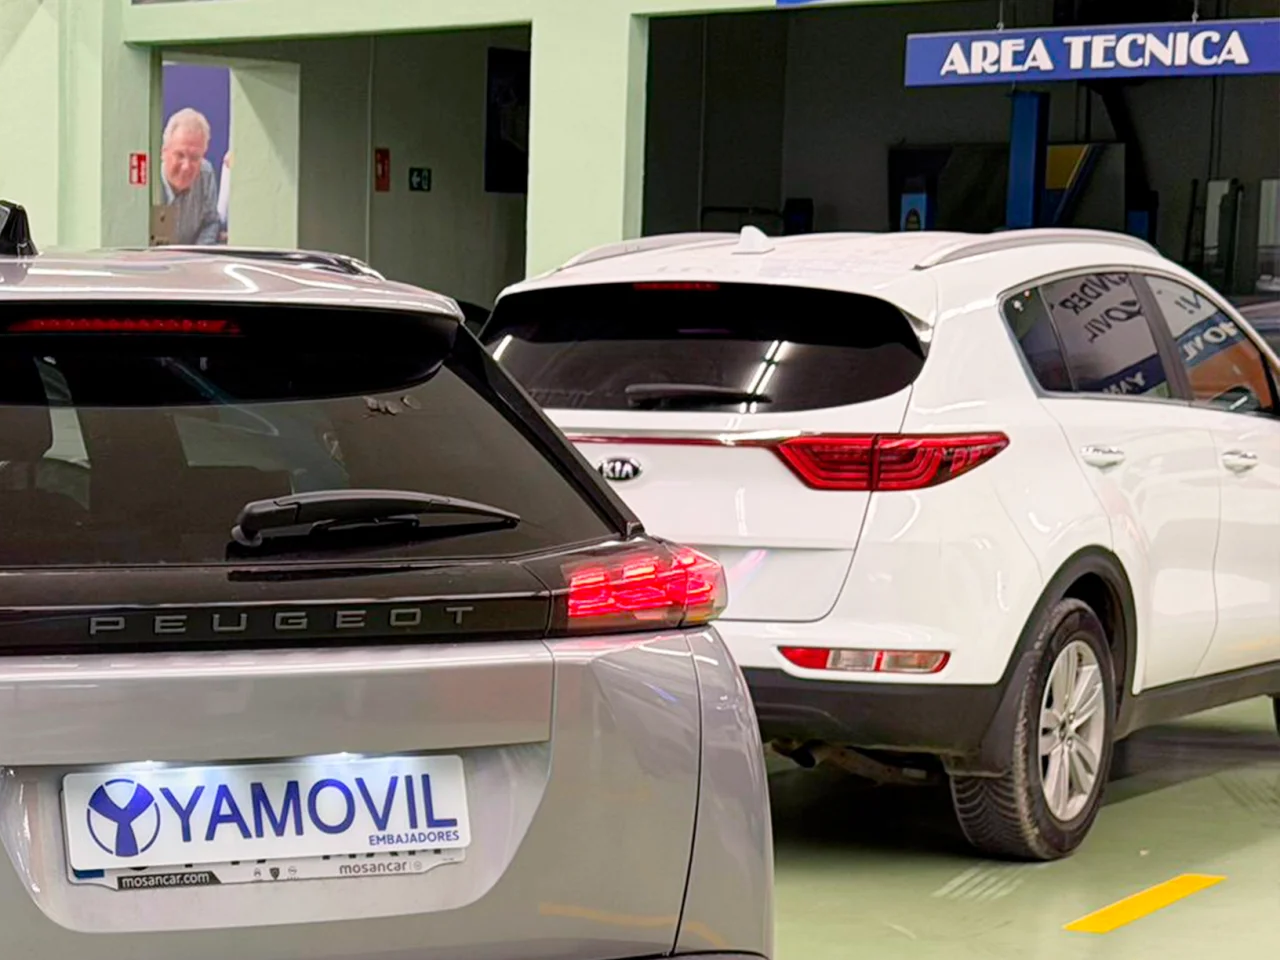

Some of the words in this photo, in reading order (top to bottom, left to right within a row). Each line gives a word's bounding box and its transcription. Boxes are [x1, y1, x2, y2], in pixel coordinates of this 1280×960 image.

[940, 37, 1054, 76] AREA
[1063, 30, 1250, 69] TECNICA
[602, 460, 634, 478] KIA
[89, 606, 474, 636] PEUGEOT
[158, 773, 458, 843] YAMOVIL
[368, 830, 460, 847] EMBAJADORES
[339, 860, 407, 875] mosancar
[122, 872, 210, 888] mosancar.com
